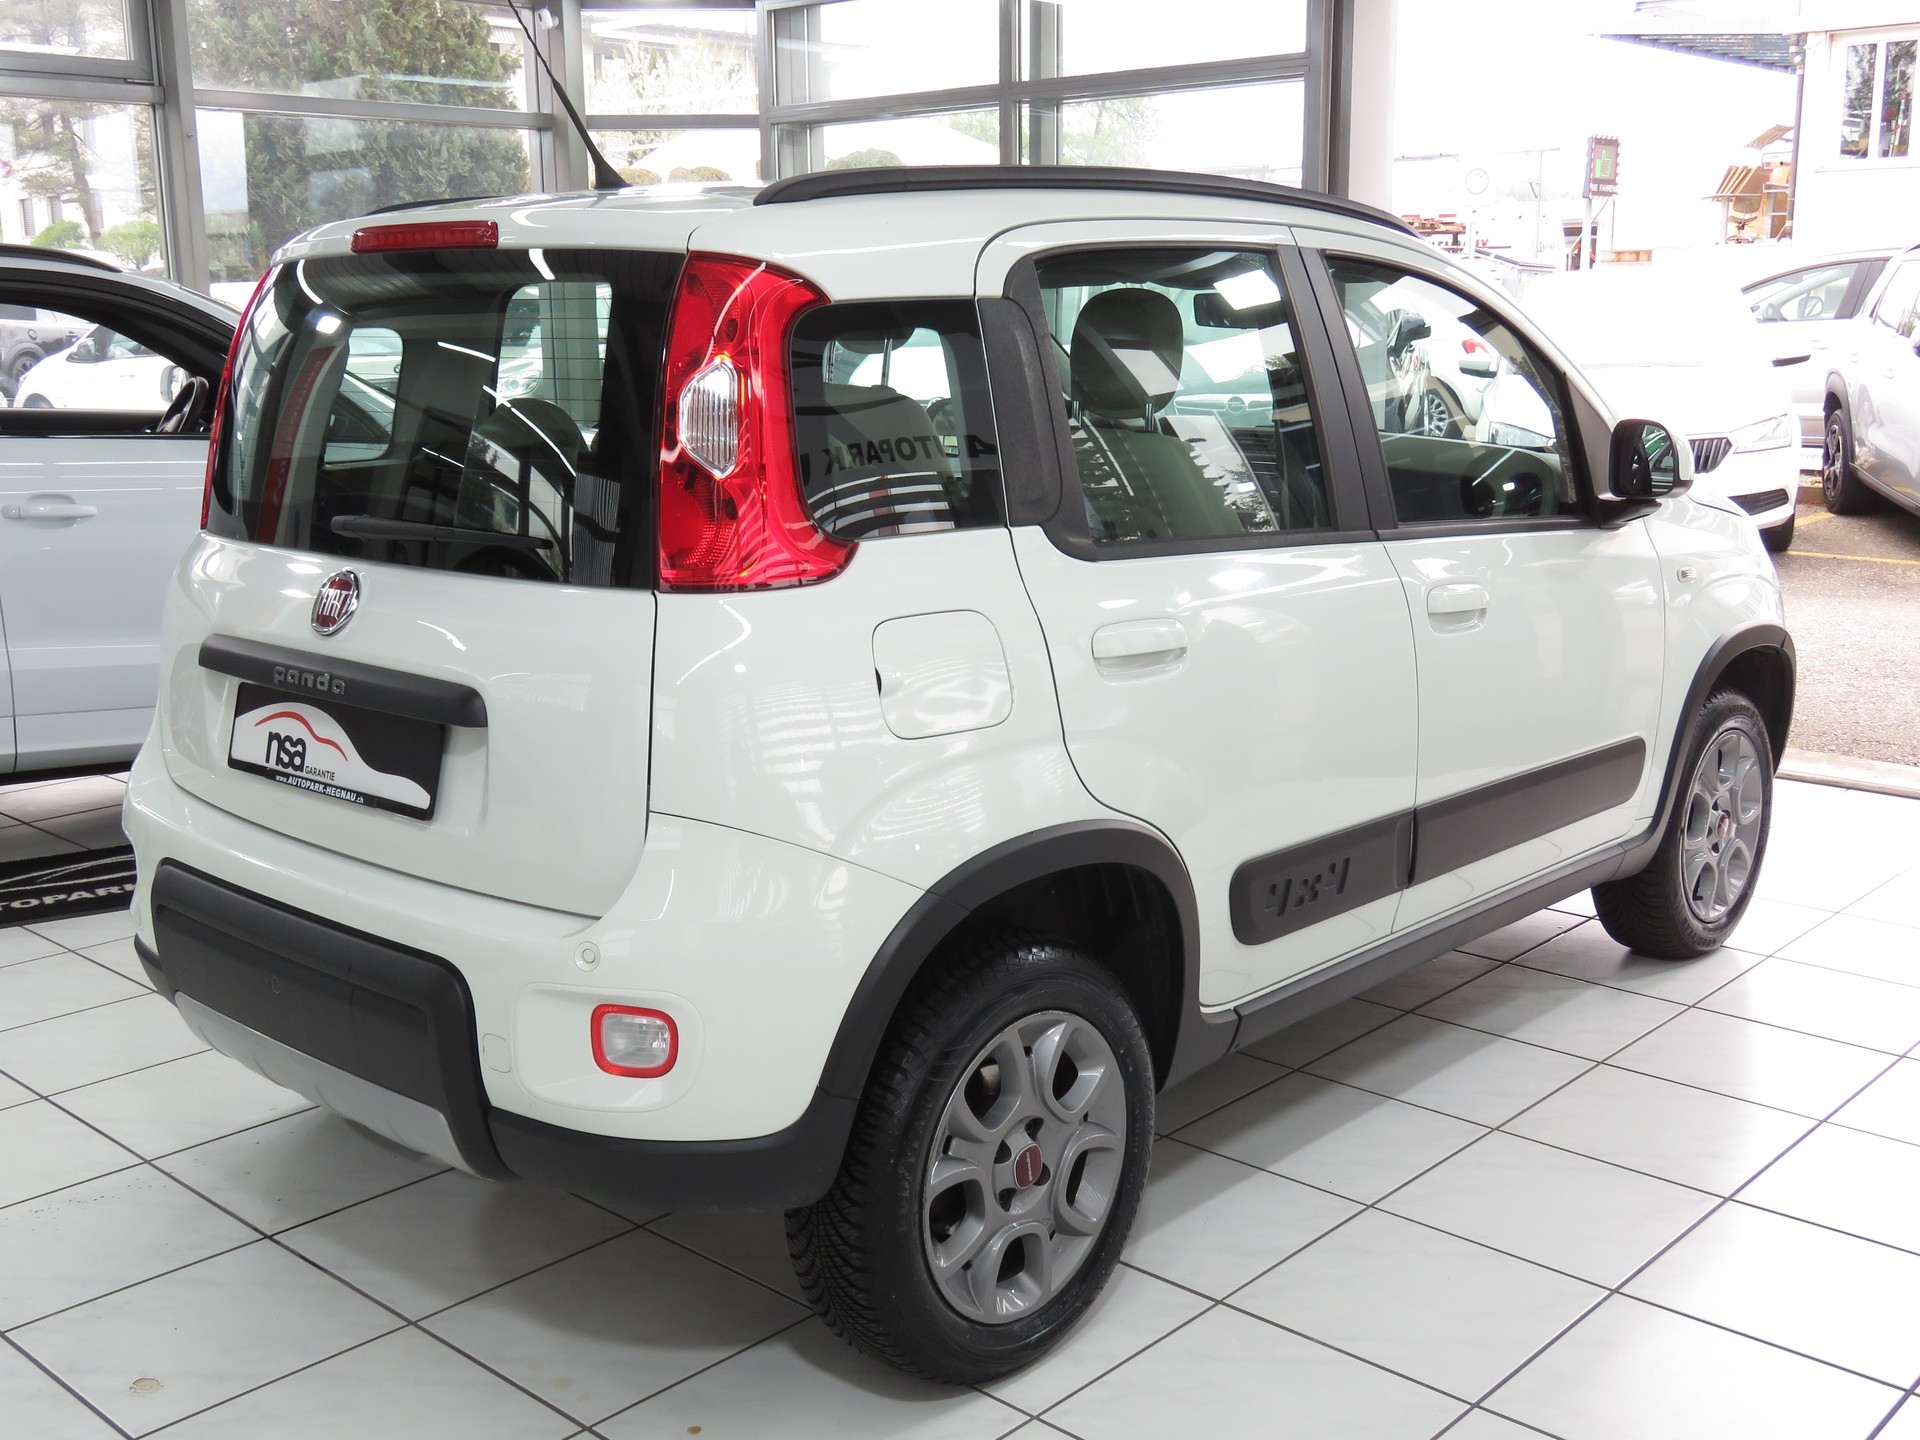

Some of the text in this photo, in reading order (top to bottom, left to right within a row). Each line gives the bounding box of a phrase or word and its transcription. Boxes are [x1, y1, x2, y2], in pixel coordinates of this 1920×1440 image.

[318, 588, 349, 618] FIAT
[273, 666, 345, 695] panda
[265, 731, 307, 773] nsa
[305, 766, 336, 781] GARANTIE
[275, 774, 364, 804] www.AUTOPARK-HEGNAU.ch
[1264, 857, 1350, 917] 4x4
